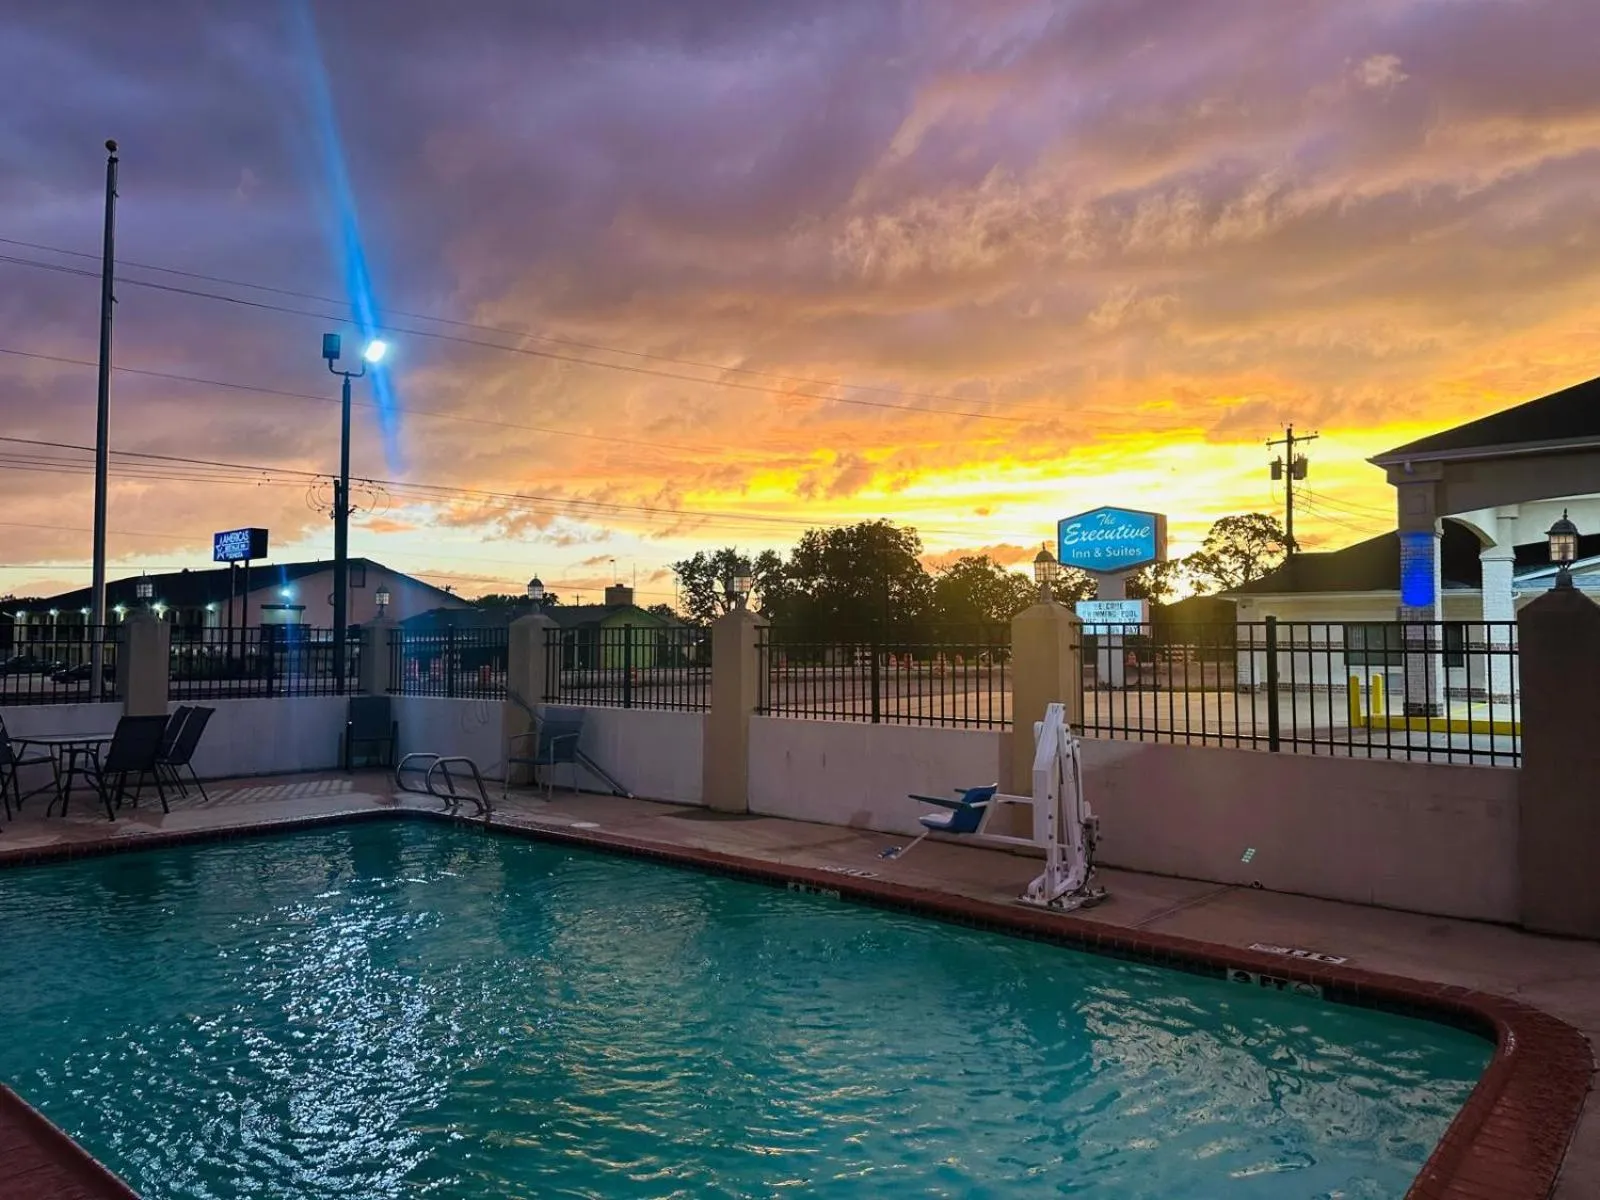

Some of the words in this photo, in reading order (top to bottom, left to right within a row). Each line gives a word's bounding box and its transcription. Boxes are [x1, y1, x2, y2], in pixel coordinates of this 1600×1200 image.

[1096, 513, 1116, 526] The
[1063, 522, 1151, 546] Executive
[1072, 547, 1091, 558] Inn
[1094, 547, 1102, 558] &
[1105, 545, 1142, 557] Suites
